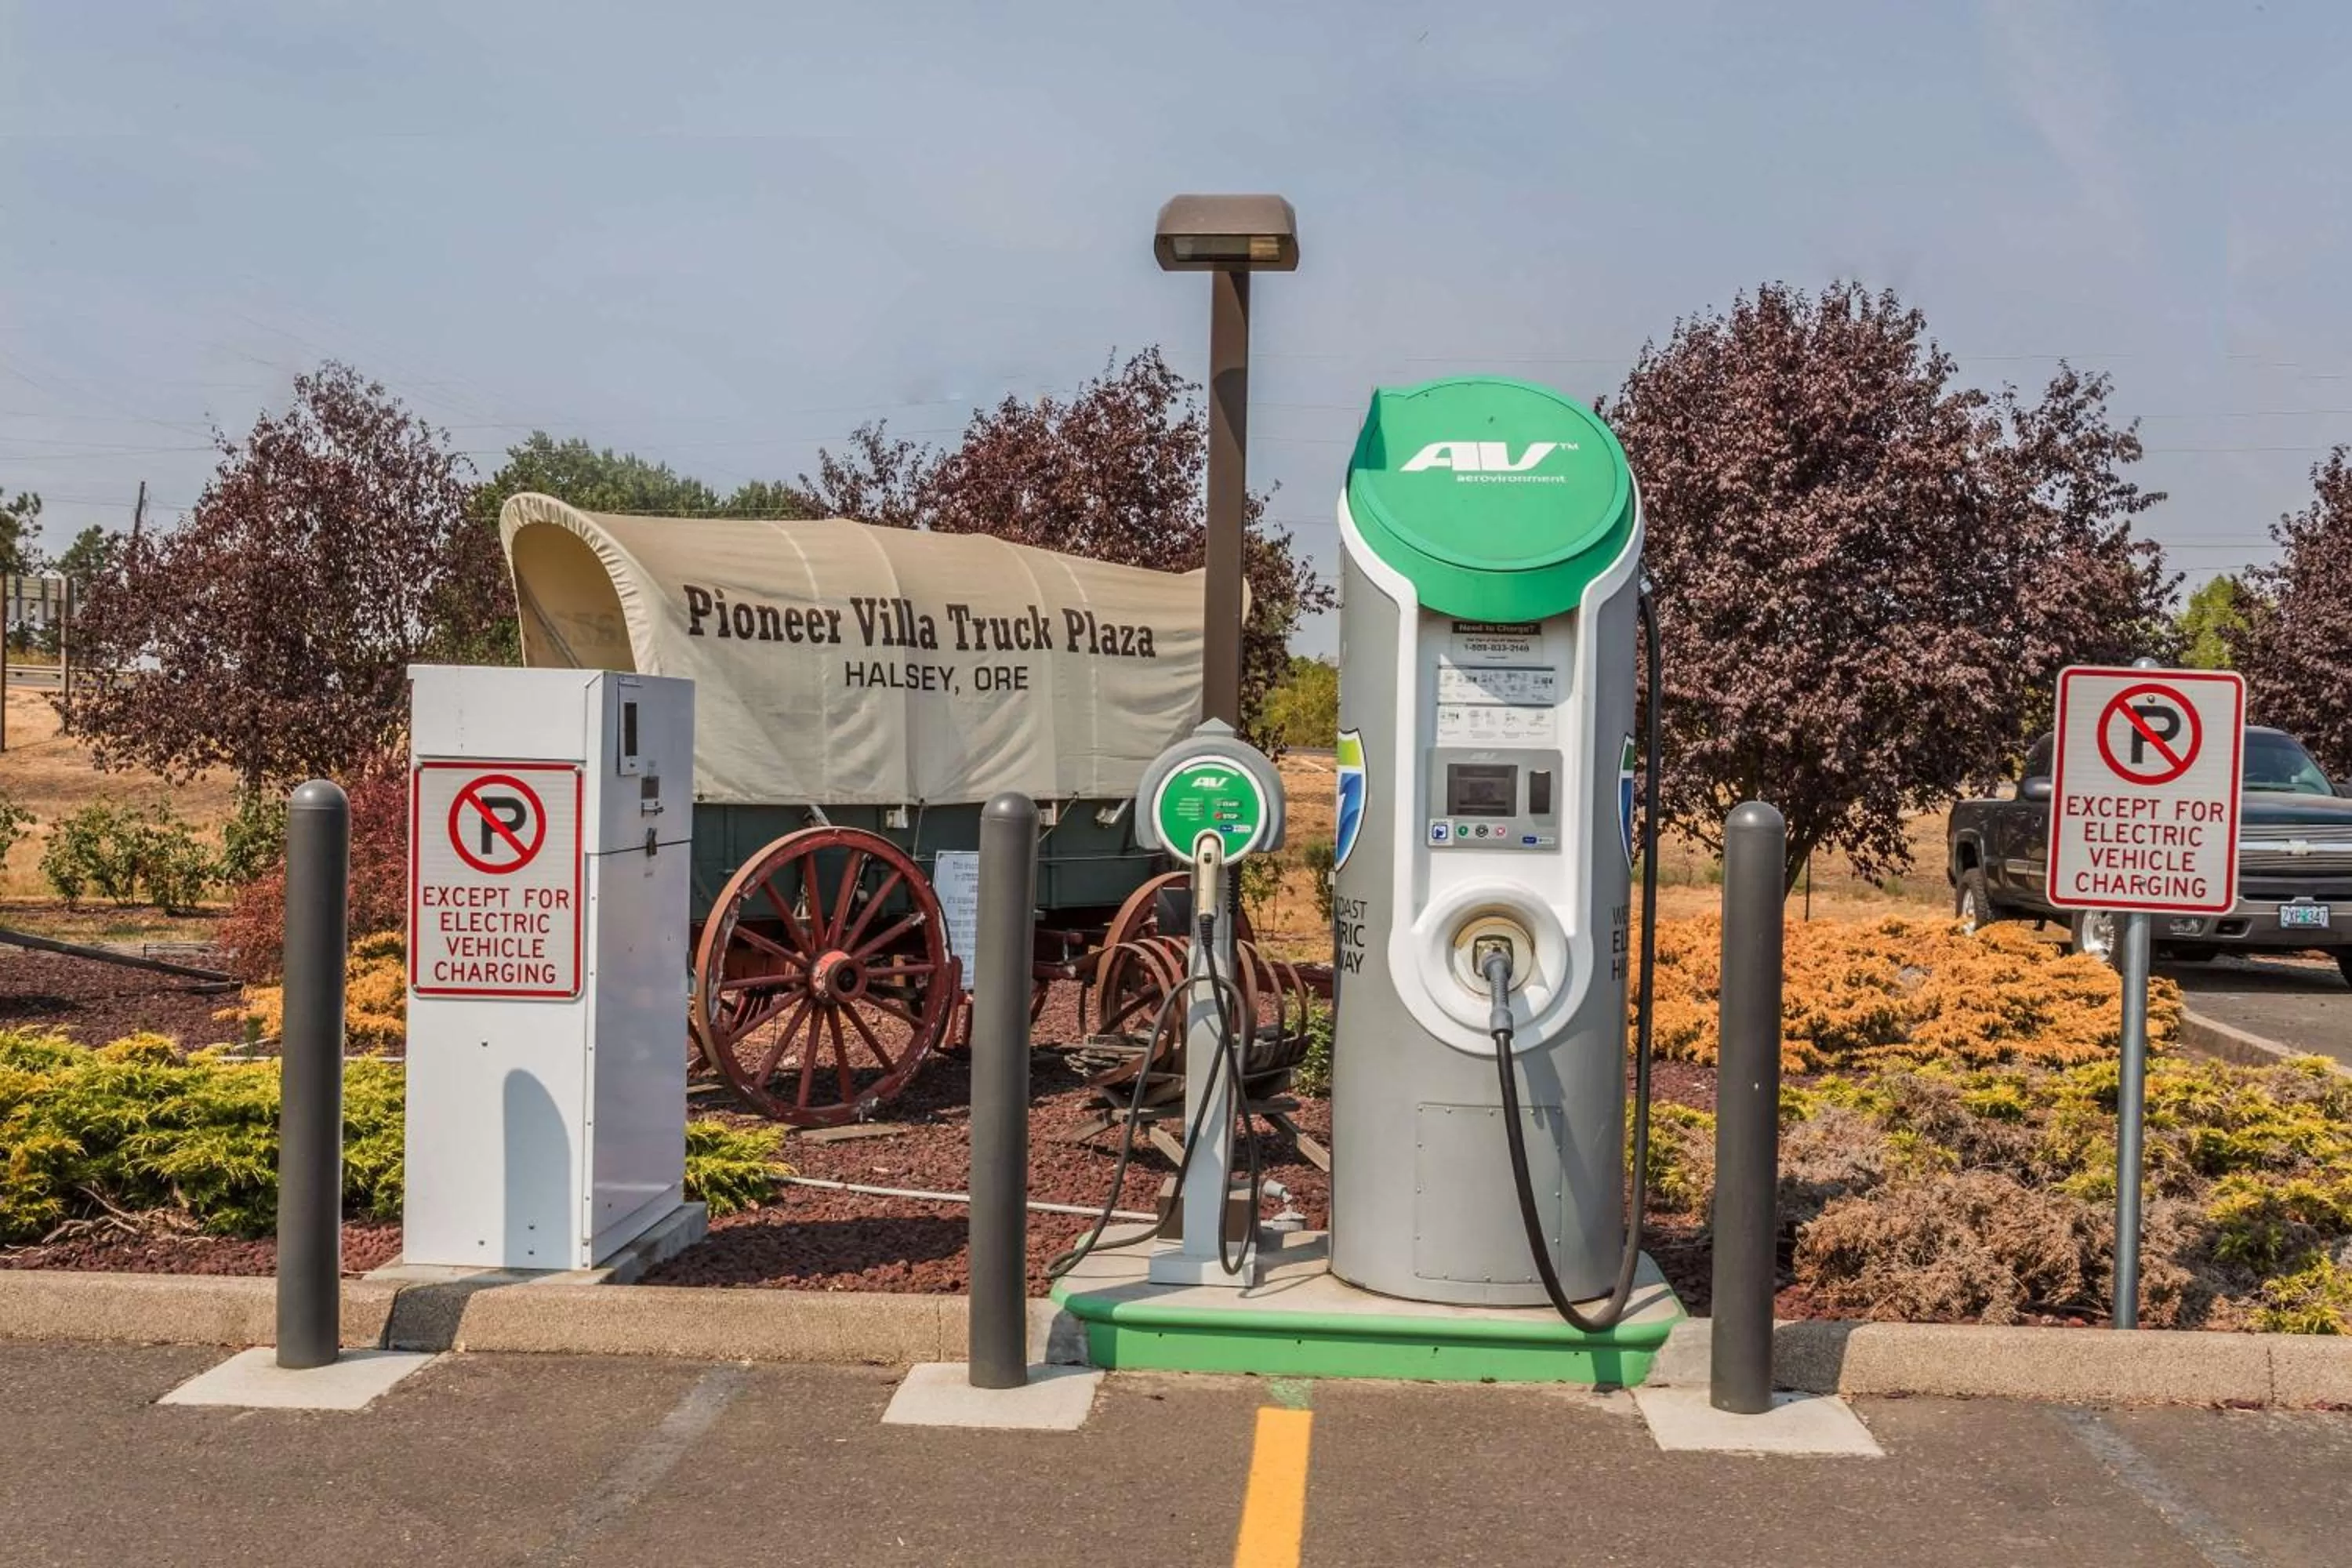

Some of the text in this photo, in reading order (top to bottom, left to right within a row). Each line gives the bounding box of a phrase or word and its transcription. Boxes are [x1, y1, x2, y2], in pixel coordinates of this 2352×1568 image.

[1457, 474, 1566, 484] aerovironment
[683, 584, 1156, 657] Pioneer Villa Truck Plaza
[845, 661, 1029, 696] HALSEY, ORE
[2066, 796, 2224, 823] EXCEPT FOR
[2084, 822, 2203, 847] ELECTRIC
[2089, 848, 2196, 872] VEHICLE
[2075, 872, 2207, 898] CHARGING
[423, 887, 569, 909] EXCEPT FOR
[440, 912, 550, 933] ELECTRIC
[445, 937, 545, 959] VEHICLE
[434, 961, 556, 984] CHARGING
